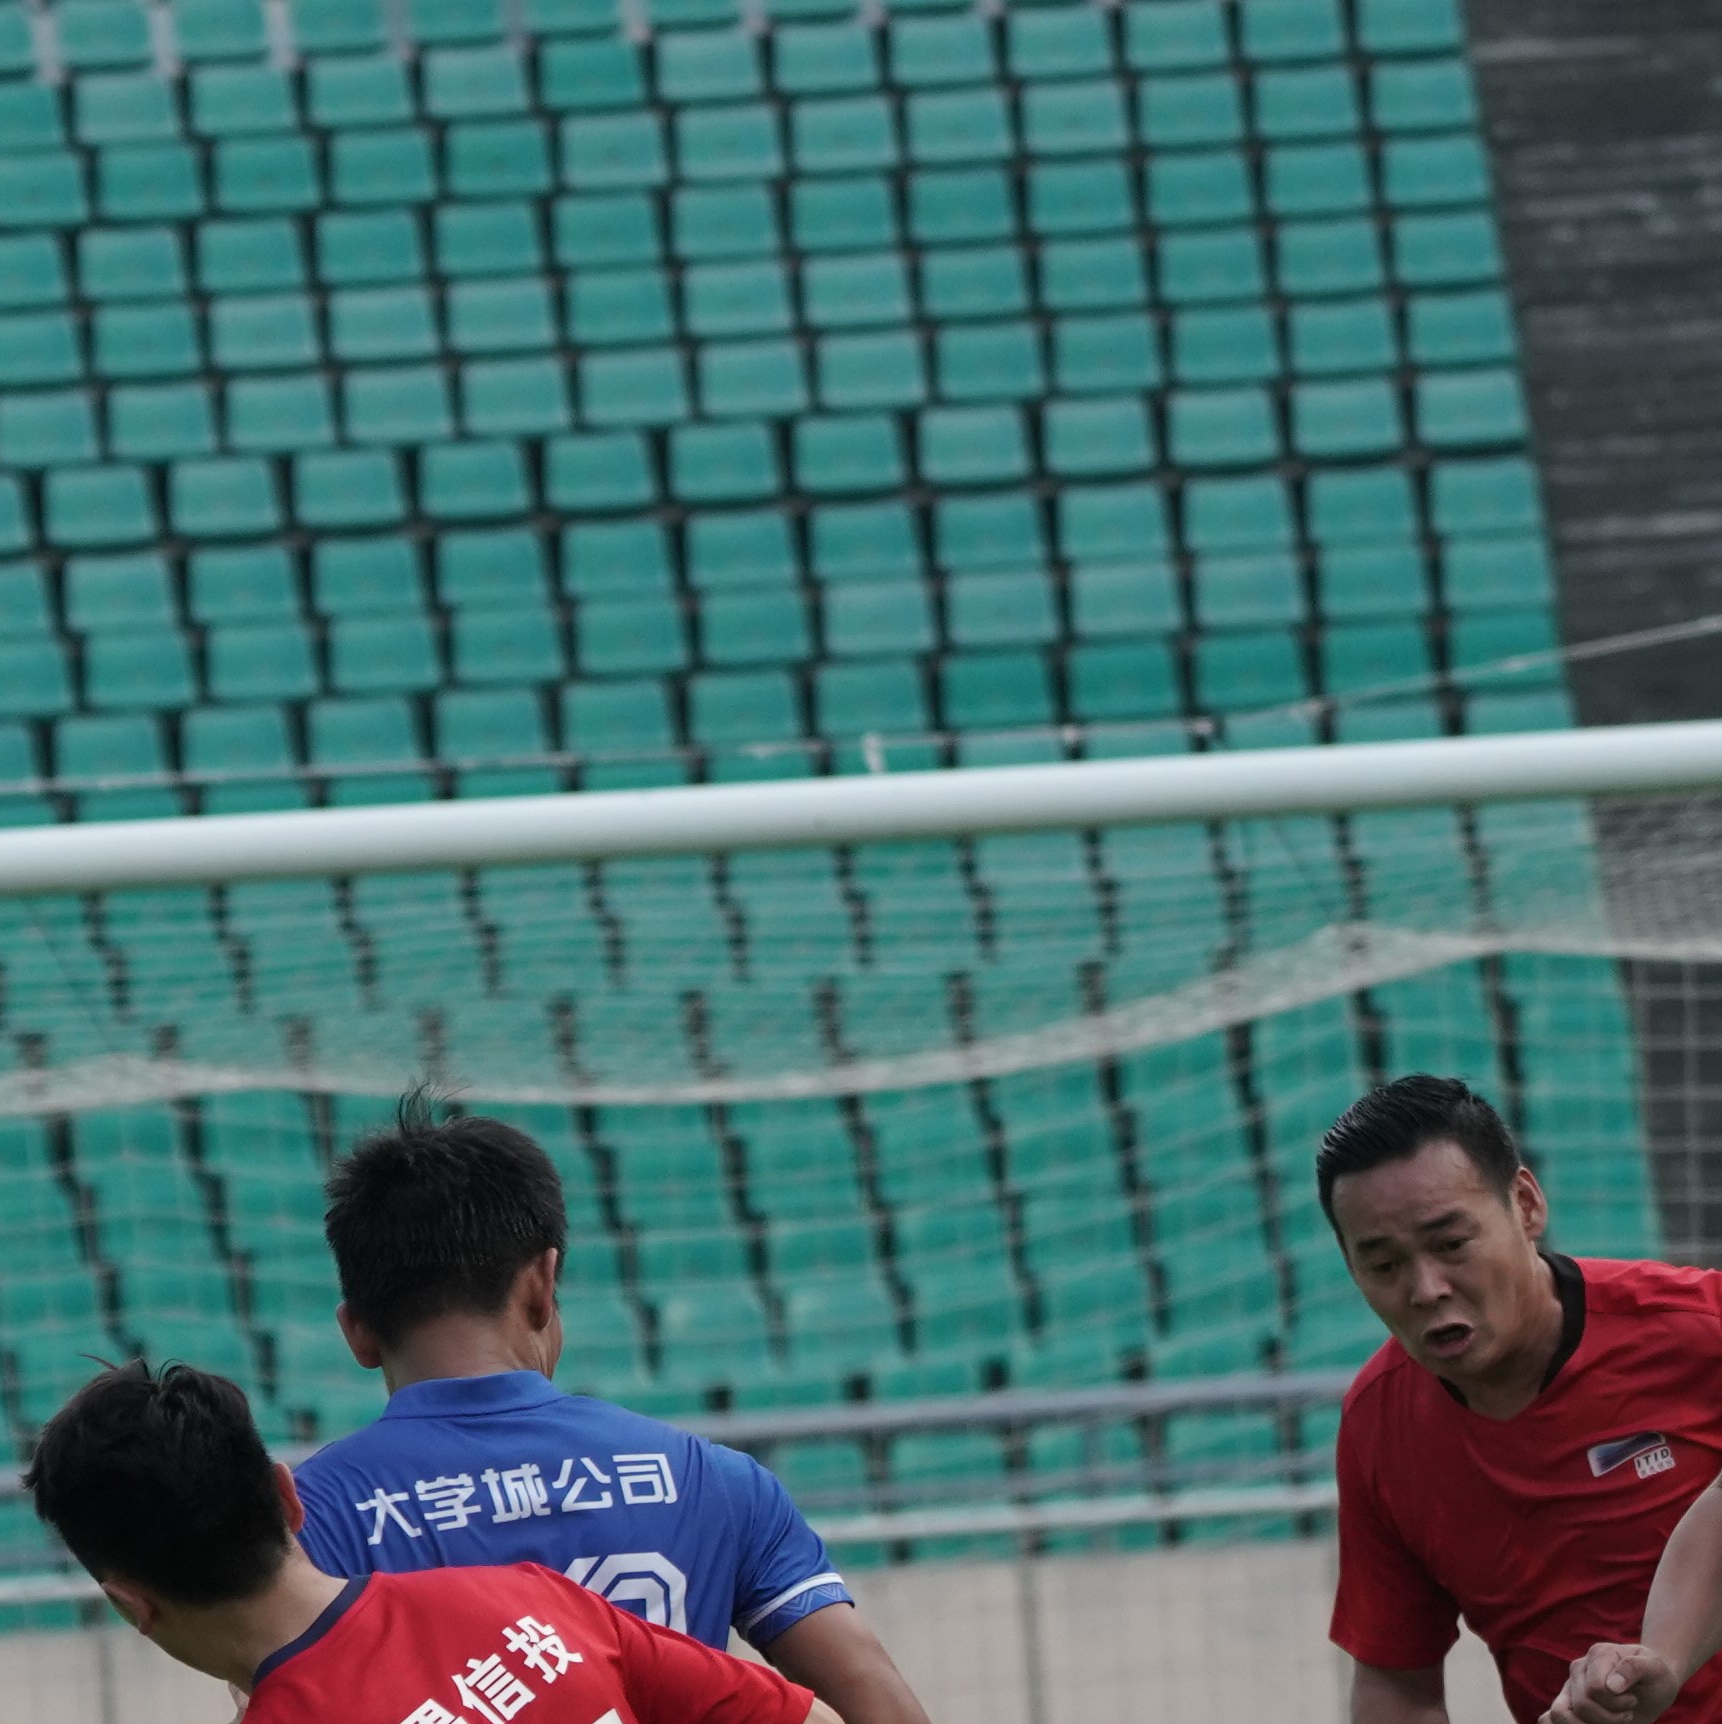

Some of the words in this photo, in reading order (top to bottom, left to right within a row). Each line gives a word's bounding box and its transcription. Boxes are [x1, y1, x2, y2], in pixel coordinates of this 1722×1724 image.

[356, 1452, 678, 1546] 大学城公司
